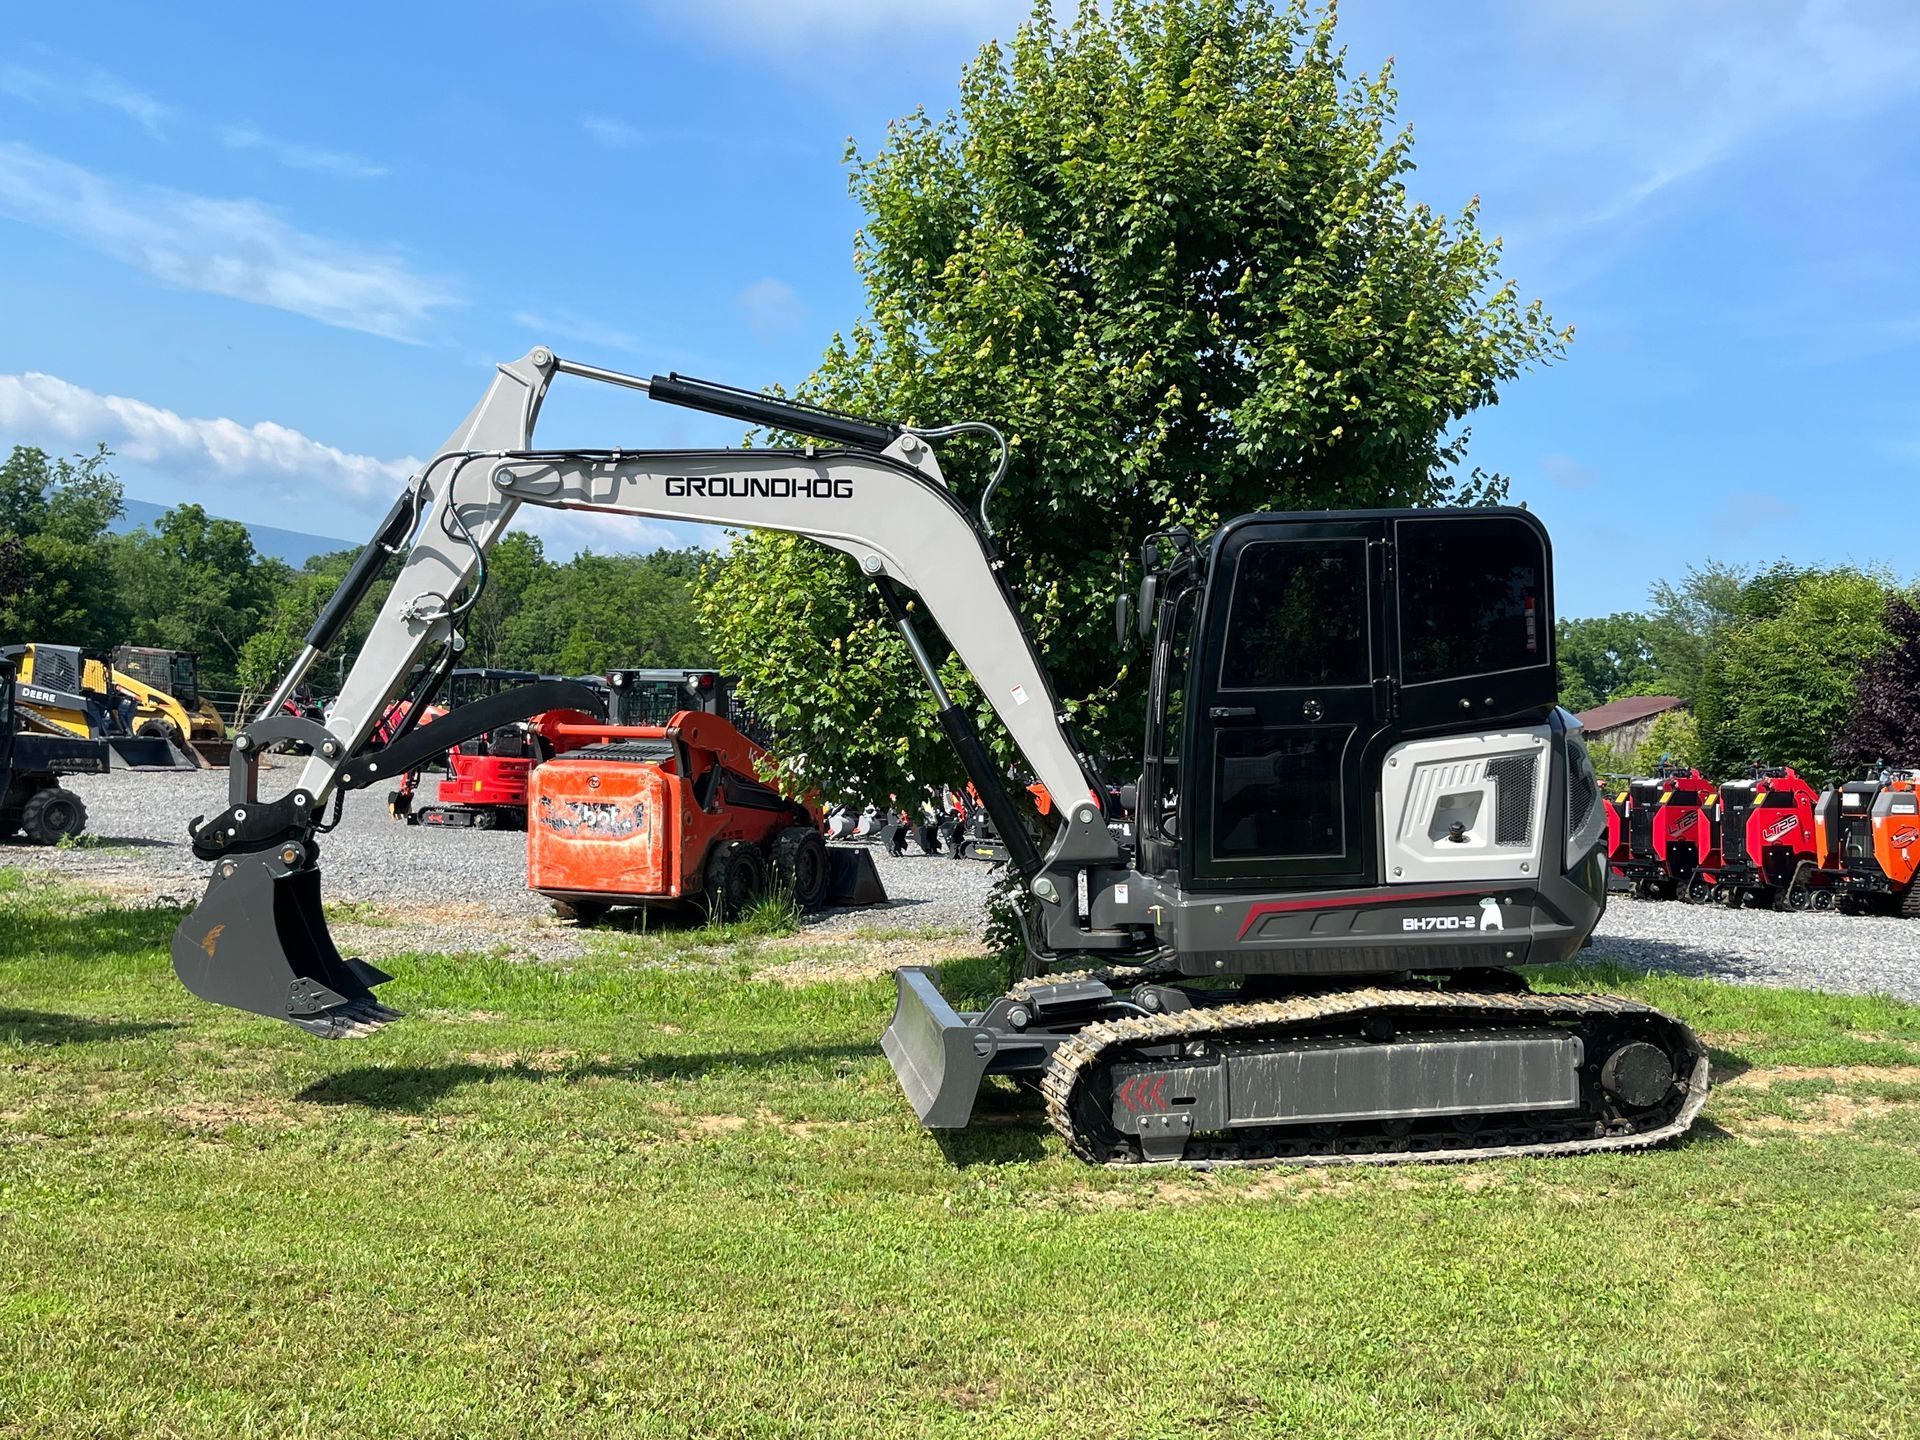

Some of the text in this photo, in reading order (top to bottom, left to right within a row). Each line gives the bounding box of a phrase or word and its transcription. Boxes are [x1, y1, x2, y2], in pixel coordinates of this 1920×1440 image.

[665, 477, 853, 498] GROUNDHOG
[21, 687, 56, 703] DEERE
[1763, 815, 1798, 840] LT25
